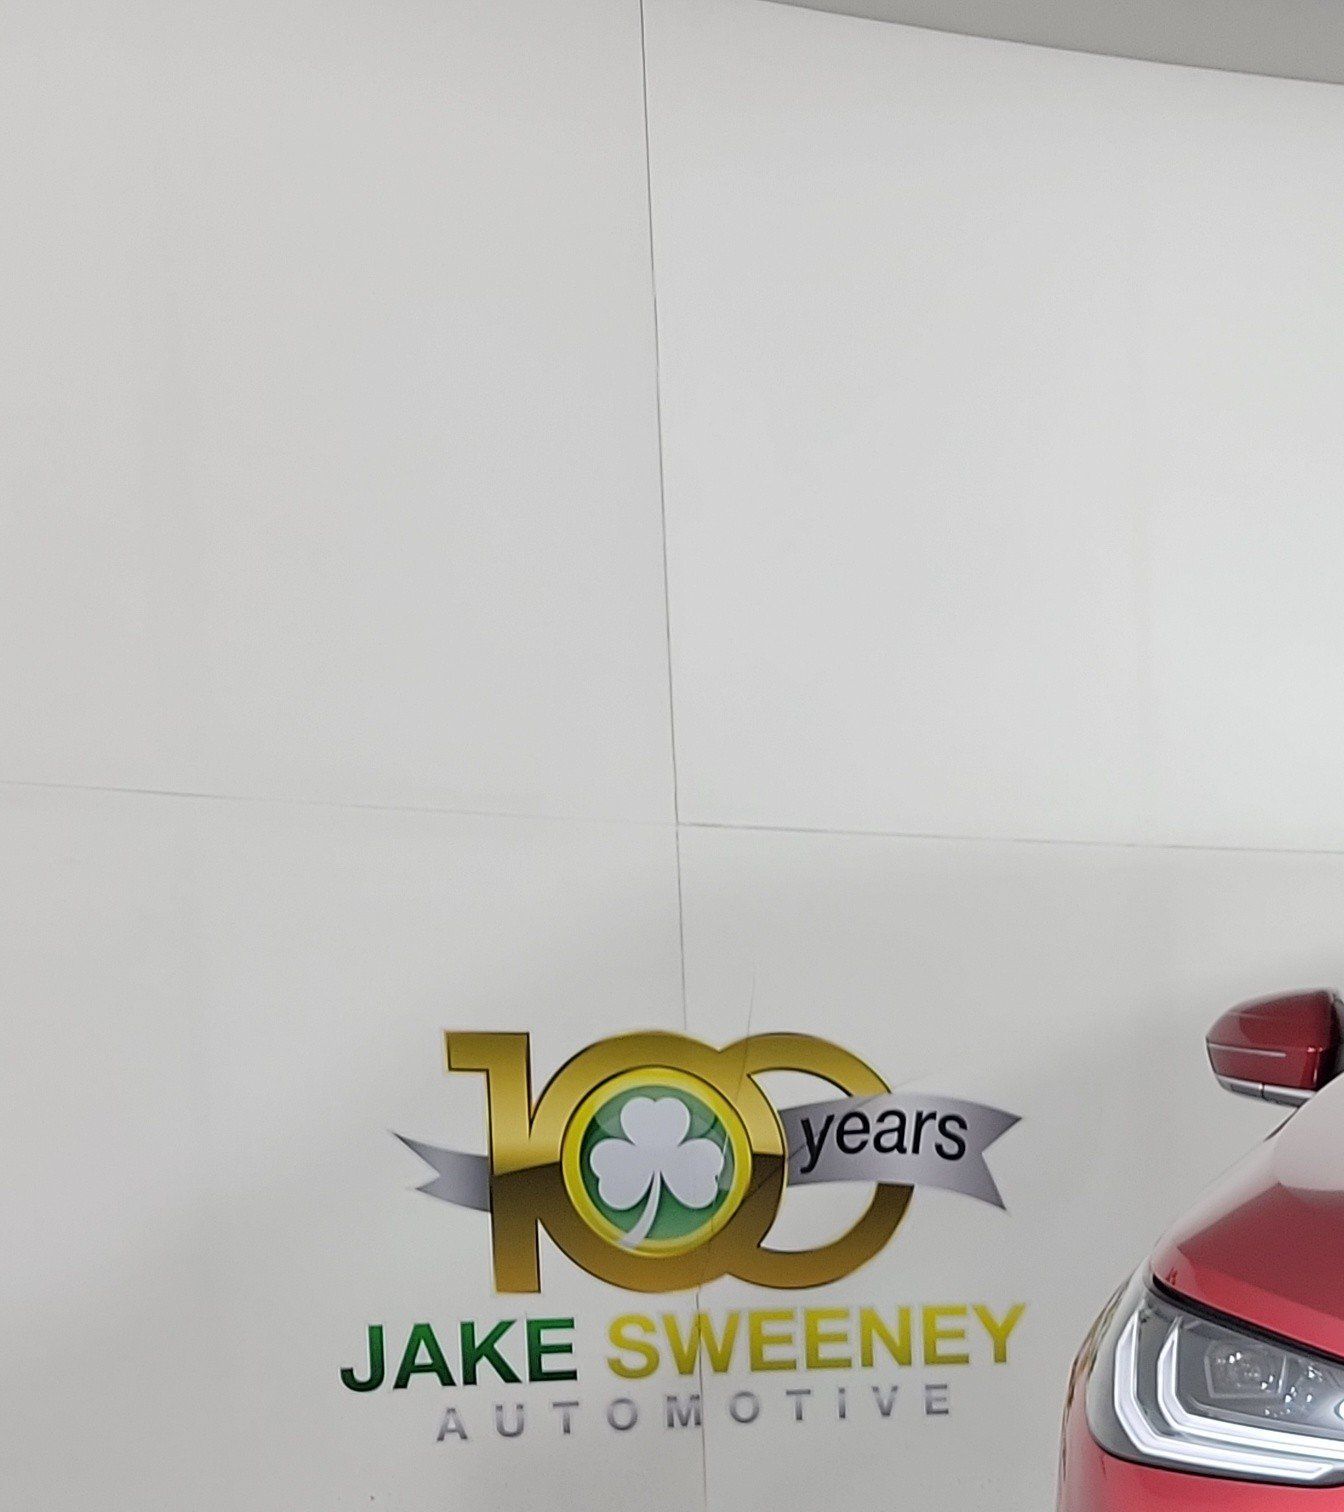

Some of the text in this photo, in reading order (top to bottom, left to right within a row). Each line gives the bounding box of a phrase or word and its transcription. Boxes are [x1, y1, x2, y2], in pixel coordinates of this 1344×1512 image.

[444, 1029, 969, 1294] 100 years
[340, 1302, 1027, 1394] JAKE SWEENEY
[435, 1383, 952, 1443] AUTOMOTIVE
